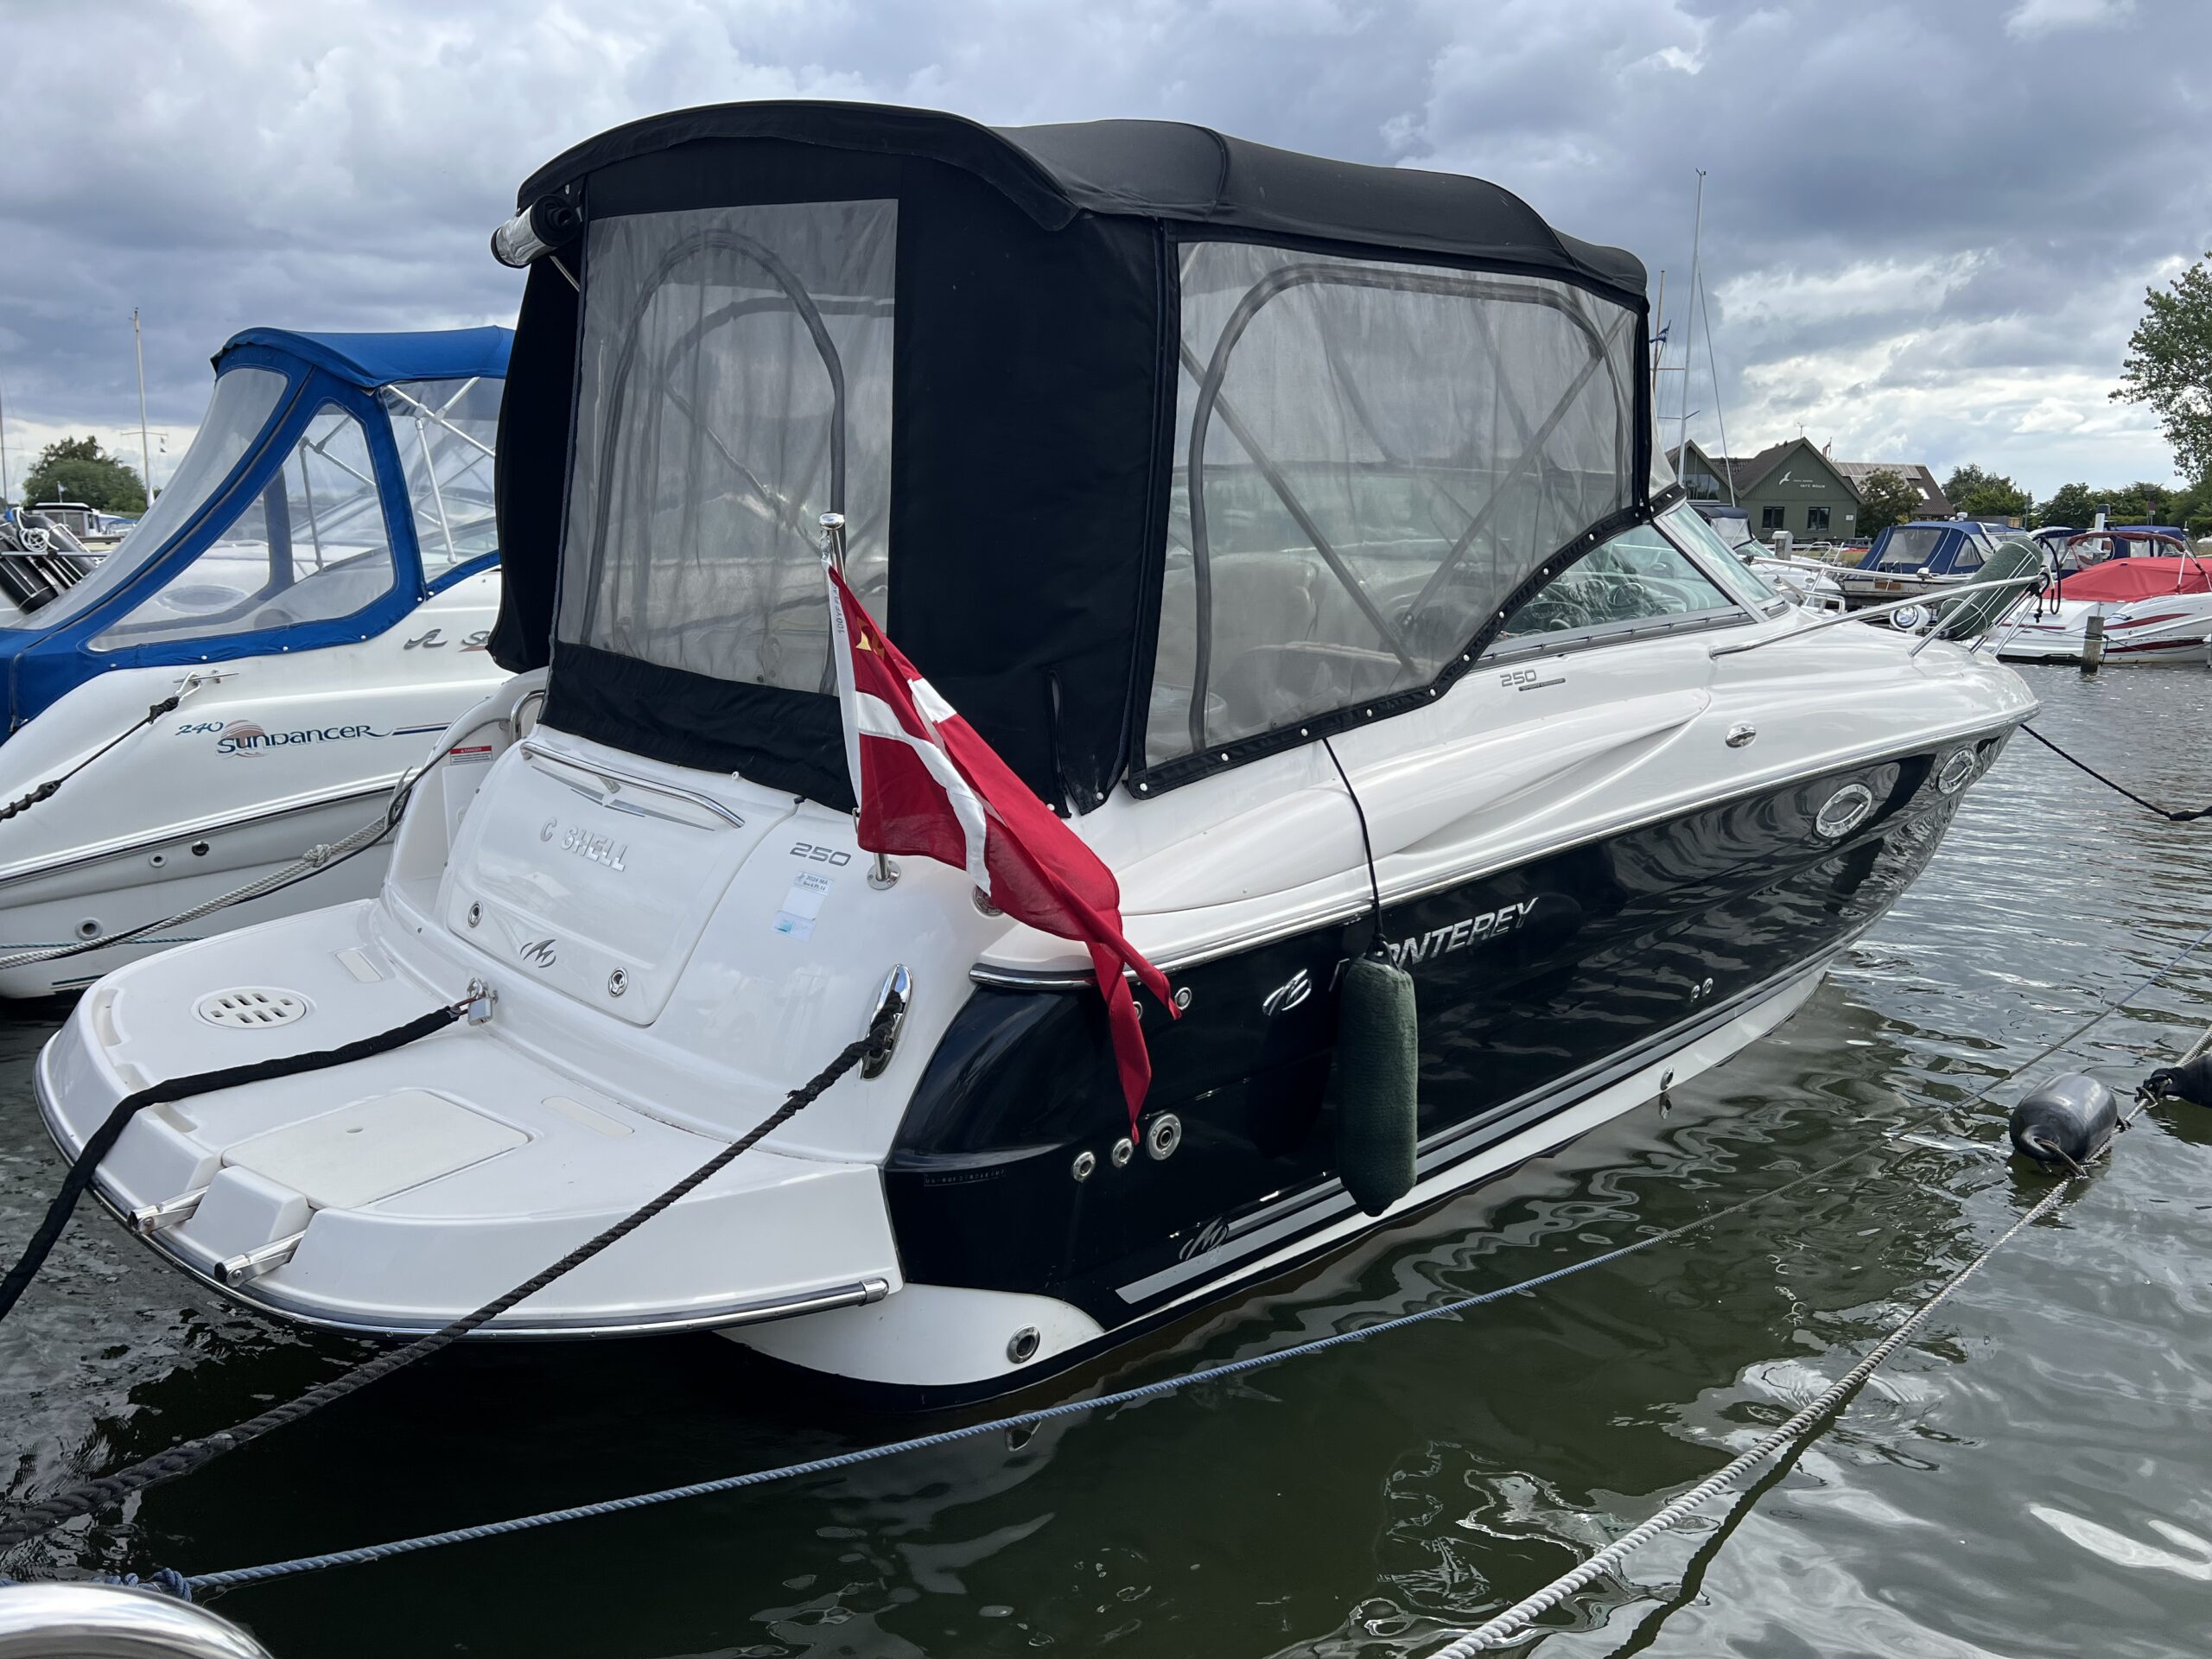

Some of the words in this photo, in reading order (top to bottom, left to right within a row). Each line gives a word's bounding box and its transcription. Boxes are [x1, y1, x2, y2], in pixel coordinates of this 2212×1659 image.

[1500, 670, 1536, 687] 250
[175, 721, 224, 735] 240
[540, 817, 557, 842] C
[560, 825, 628, 872] SHELL
[790, 842, 851, 867] 250
[1328, 897, 1539, 992] NTEREY
